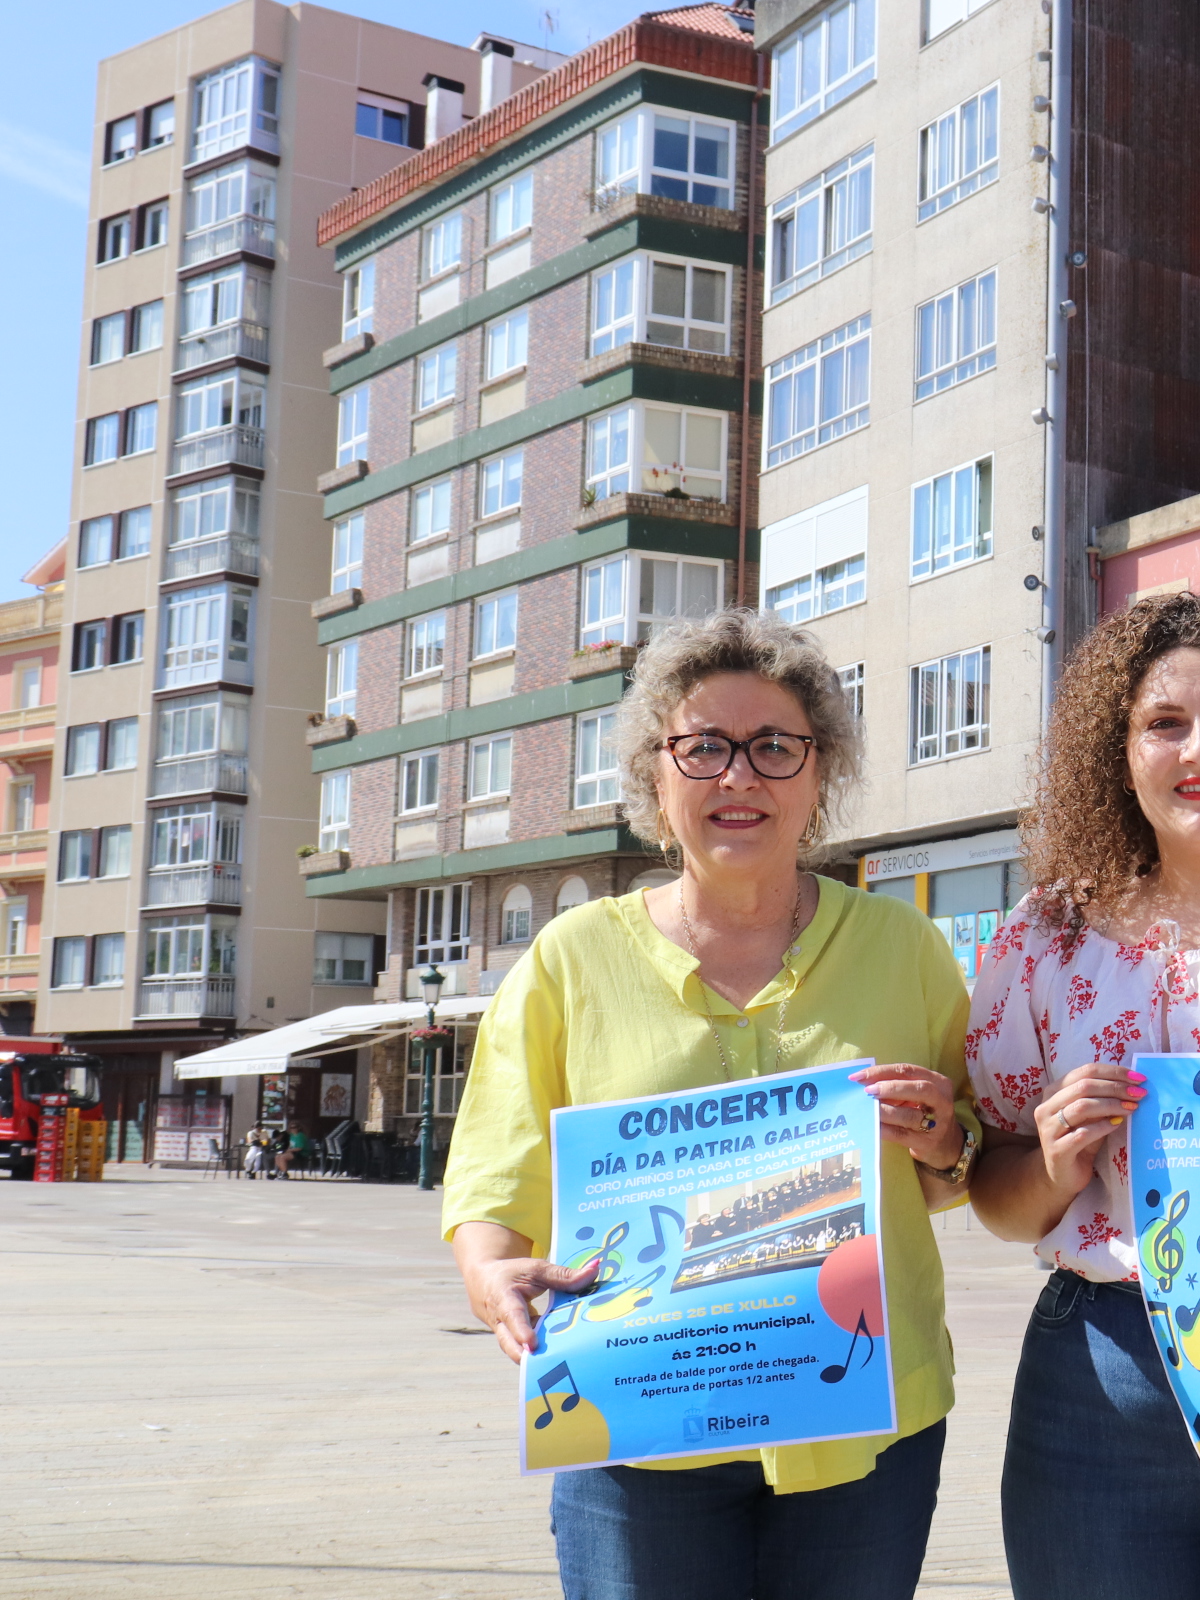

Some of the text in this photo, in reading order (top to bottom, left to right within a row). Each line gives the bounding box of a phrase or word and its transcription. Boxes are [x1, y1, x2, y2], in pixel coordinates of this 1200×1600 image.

[867, 852, 929, 875] ar SERVICIOS
[619, 1082, 818, 1140] CONCERTO
[1160, 1106, 1194, 1130] DÍA
[591, 1114, 847, 1178] DÍA DA PATRIA GALEGA
[1154, 1138, 1186, 1149] CORO
[578, 1140, 855, 1212] CANTAREIRAS DAS AMAS DE CASA DE RIBEIRA
[586, 1130, 848, 1195] CORO AIRIÑOS DA CASA DE GALICIA EN NYC
[623, 1295, 797, 1329] XOVES 25 DE XULLO
[607, 1313, 815, 1348] Novo auditorio municipal,
[672, 1341, 756, 1360] ás 21:00 h
[615, 1354, 819, 1386] Entrada de balde por orde de chegada.
[641, 1372, 795, 1398] Apertura de portas 1/2 antes
[707, 1413, 770, 1431] Ribeira
